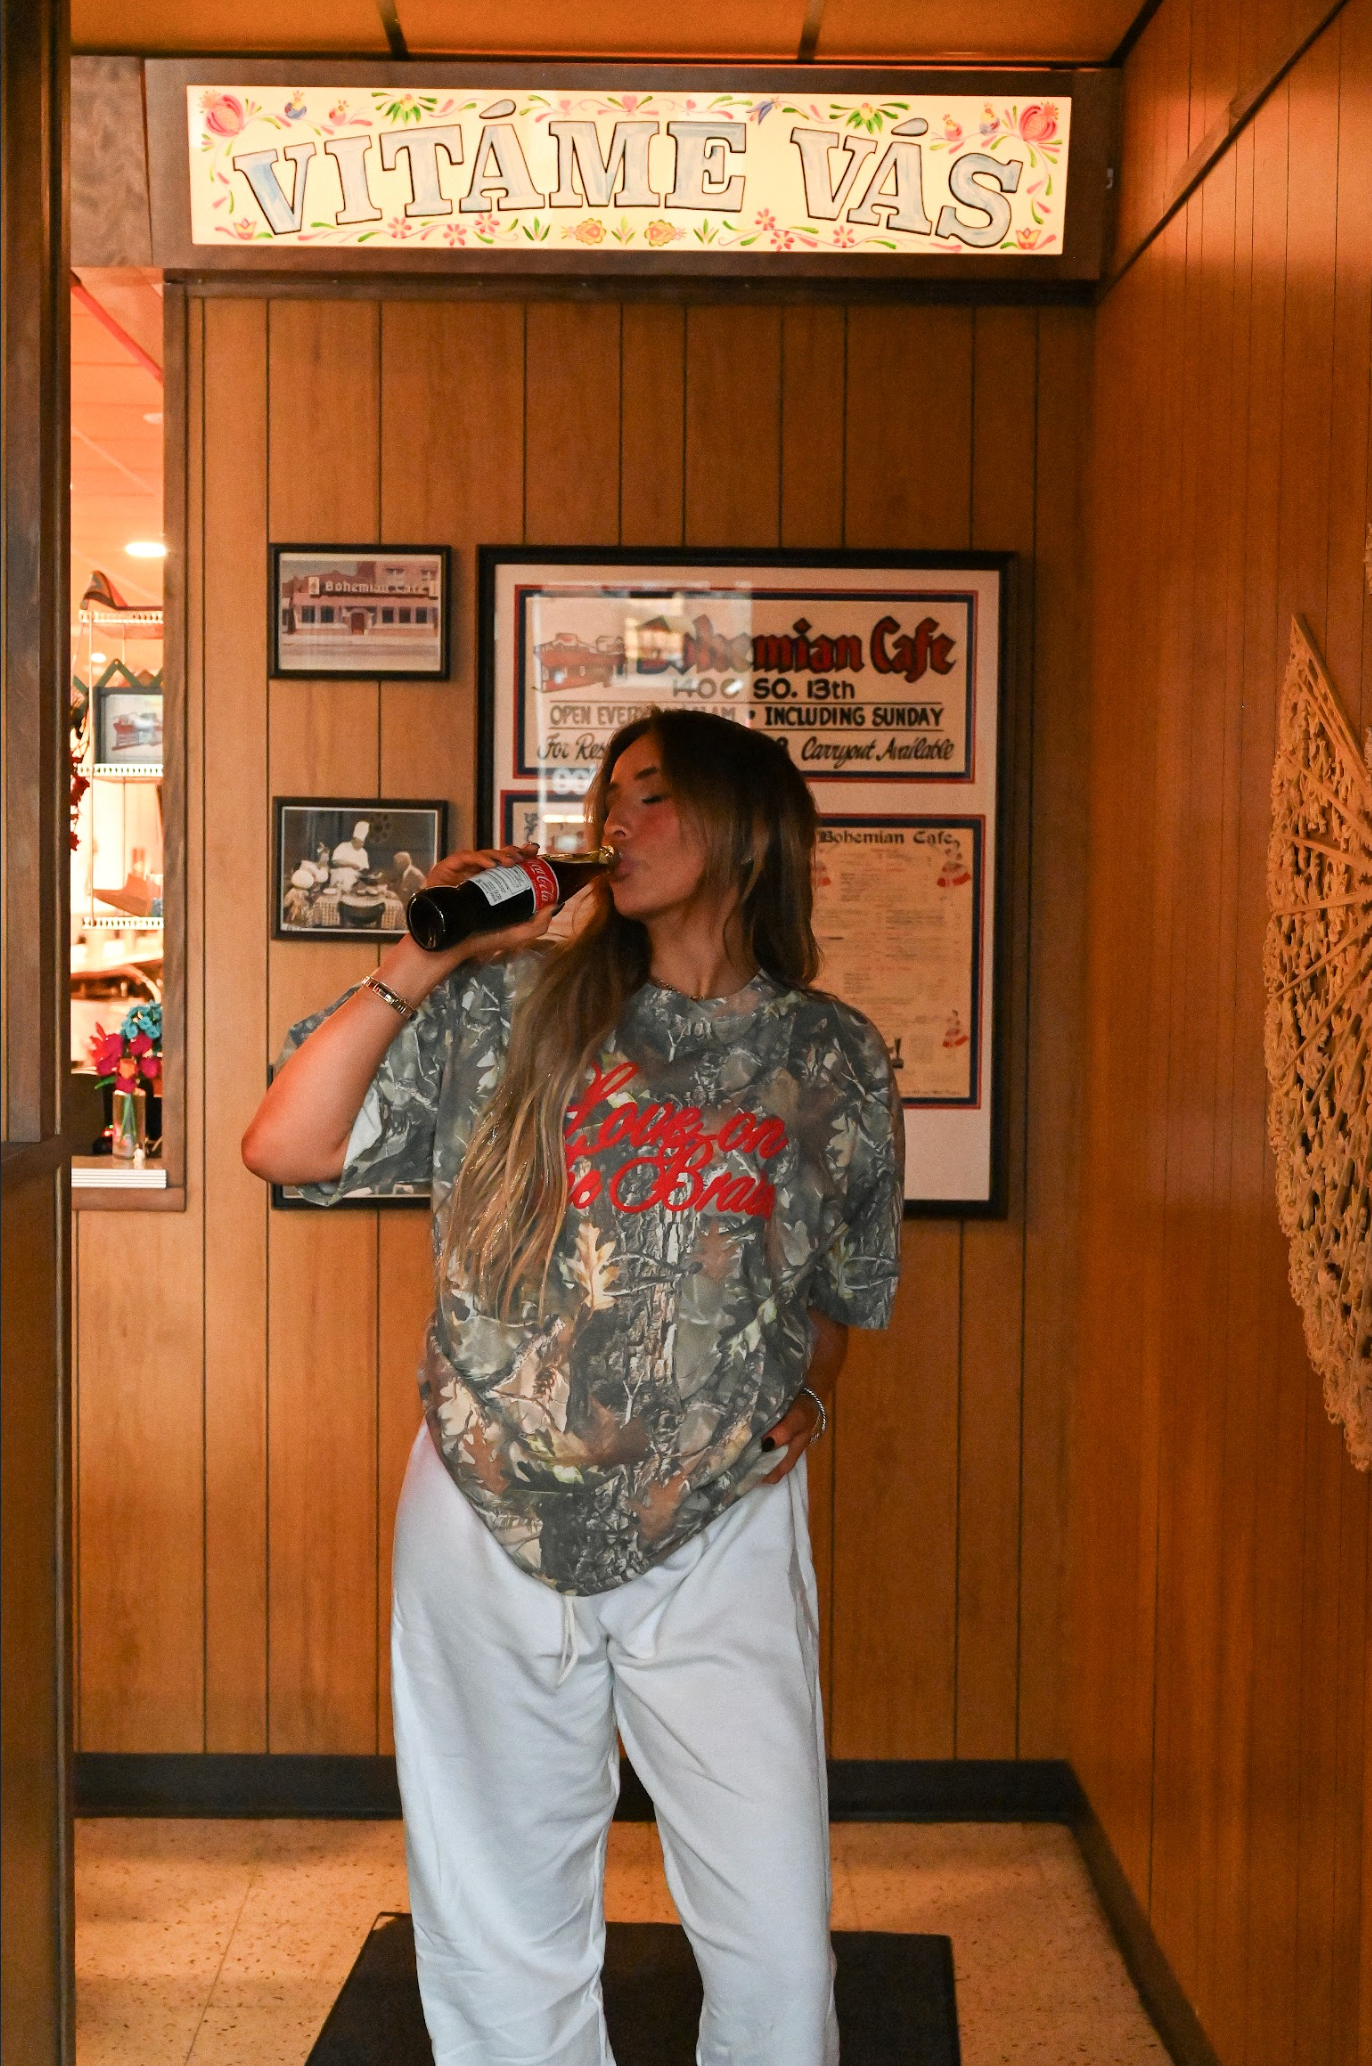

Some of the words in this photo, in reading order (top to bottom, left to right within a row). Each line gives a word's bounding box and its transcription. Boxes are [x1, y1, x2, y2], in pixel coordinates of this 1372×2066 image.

[233, 99, 747, 235] VITÁME
[790, 117, 1023, 248] VÁS
[869, 615, 957, 684] Cafe
[753, 677, 798, 700] SO.
[807, 678, 855, 700] 13th
[550, 705, 591, 726] OPEN
[597, 706, 649, 726] EVER
[764, 706, 866, 727] INCLUDING
[872, 707, 944, 728] SUNDAY
[537, 733, 569, 760] For
[801, 736, 876, 769] Carryout
[876, 736, 954, 761] Available
[817, 830, 905, 845] Bohemian
[717, 1112, 789, 1160] on
